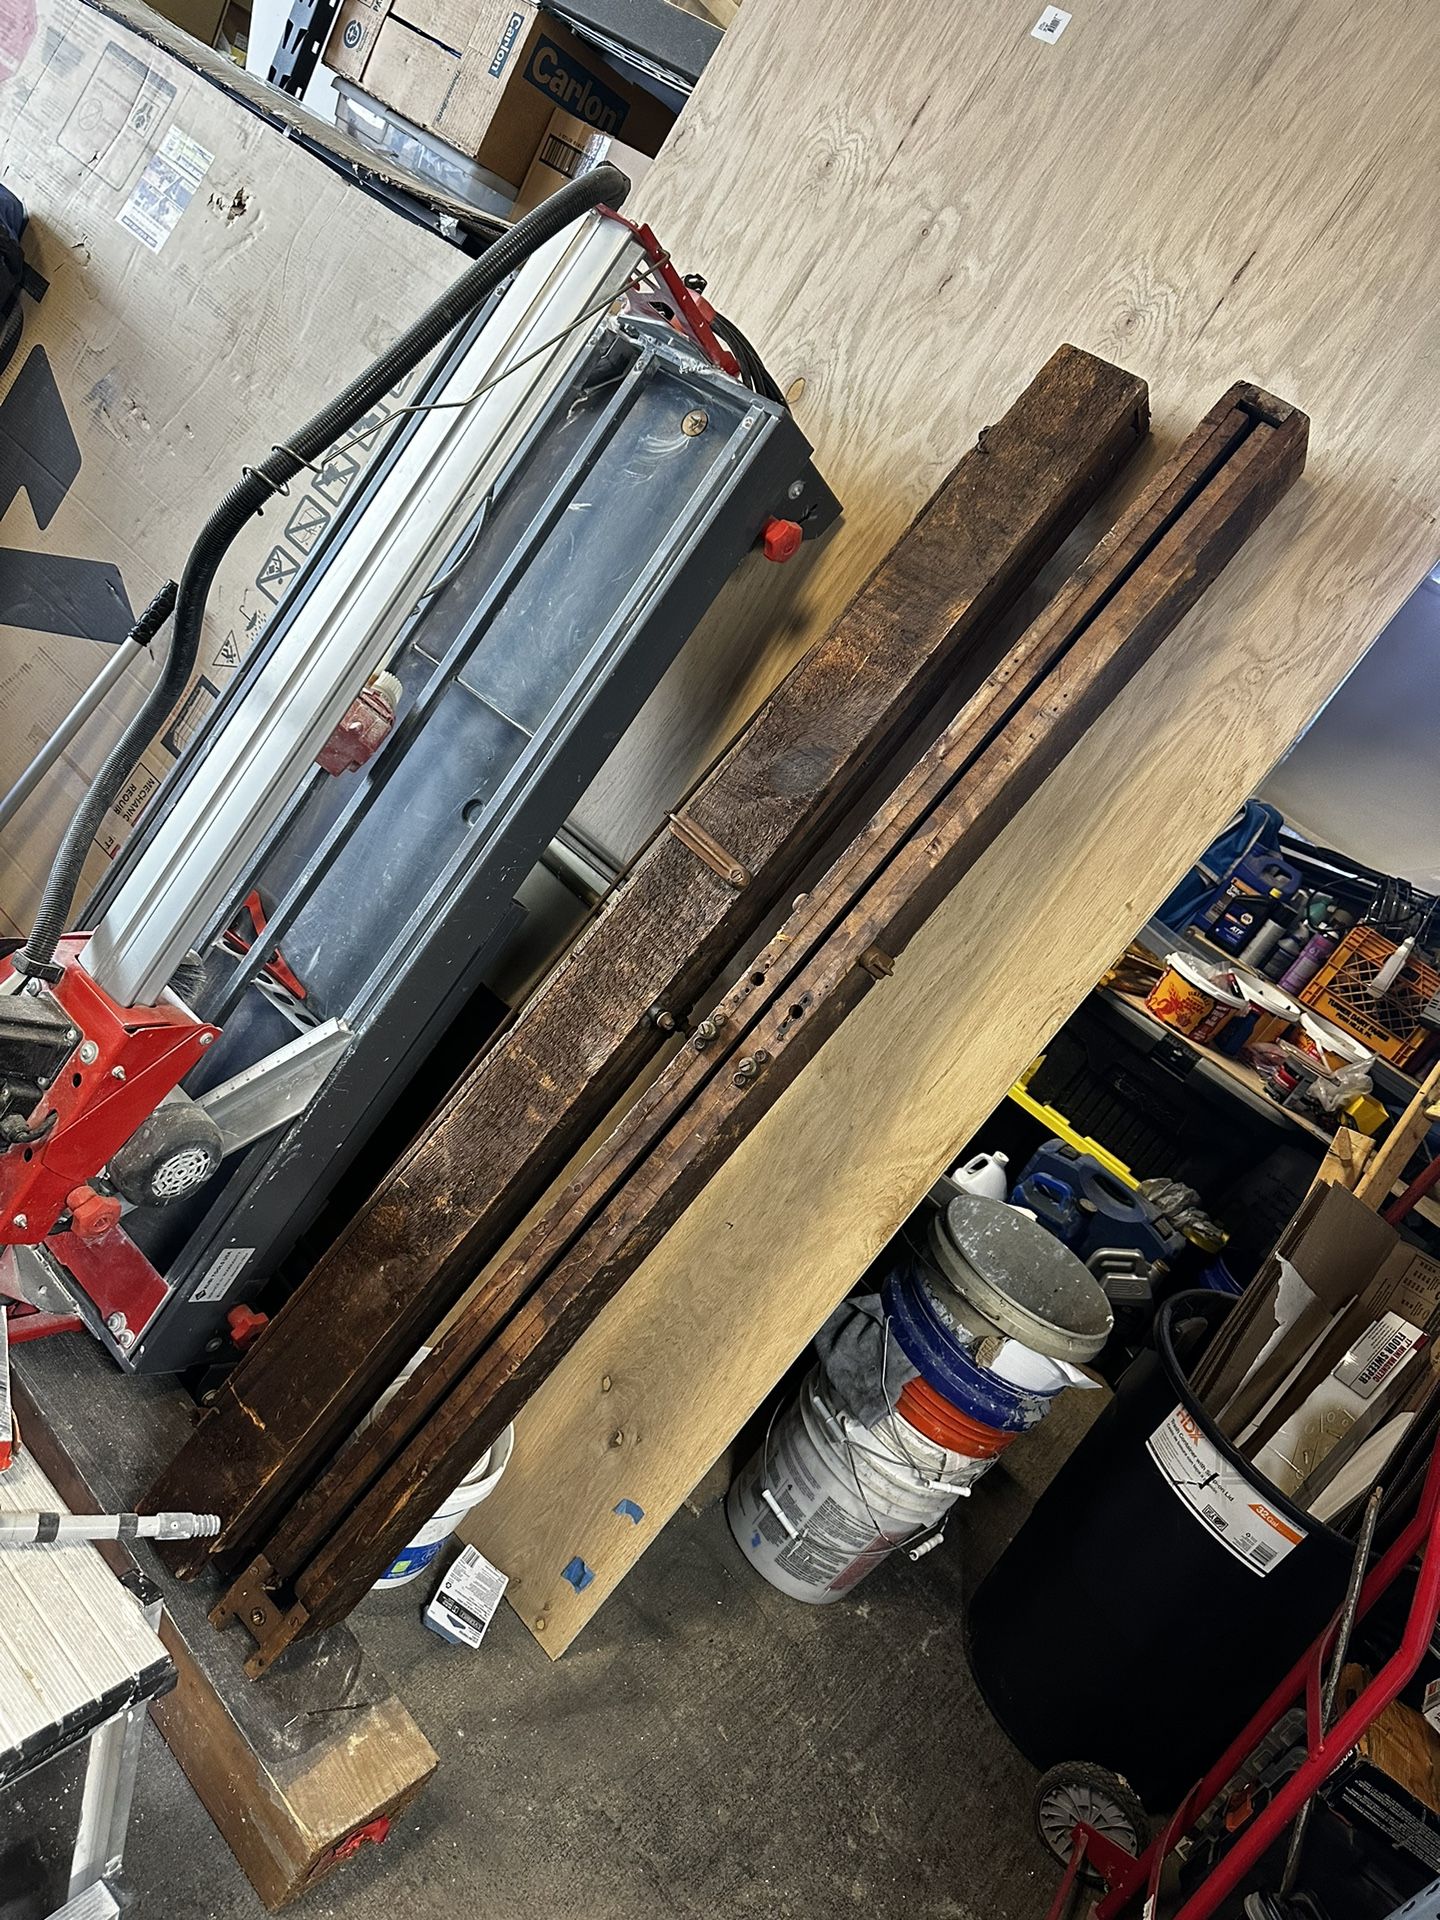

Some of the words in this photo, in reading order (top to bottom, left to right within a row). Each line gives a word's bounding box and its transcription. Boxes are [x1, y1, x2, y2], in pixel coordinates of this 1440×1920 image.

[490, 15, 522, 71] Carlon
[529, 46, 620, 133] Carlon
[1229, 925, 1244, 934] ATF
[1383, 1331, 1406, 1355] FLOOR
[1392, 1344, 1406, 1359] MINI
[1357, 1350, 1389, 1385] SWEEPER
[1371, 1355, 1397, 1383] MAGNETIC
[1174, 1407, 1205, 1447] HDX
[1178, 1430, 1198, 1459] Container
[1196, 1458, 1206, 1470] with
[1224, 1491, 1234, 1502] Lid
[1254, 1504, 1270, 1520] 32
[1265, 1514, 1279, 1528] Gal
